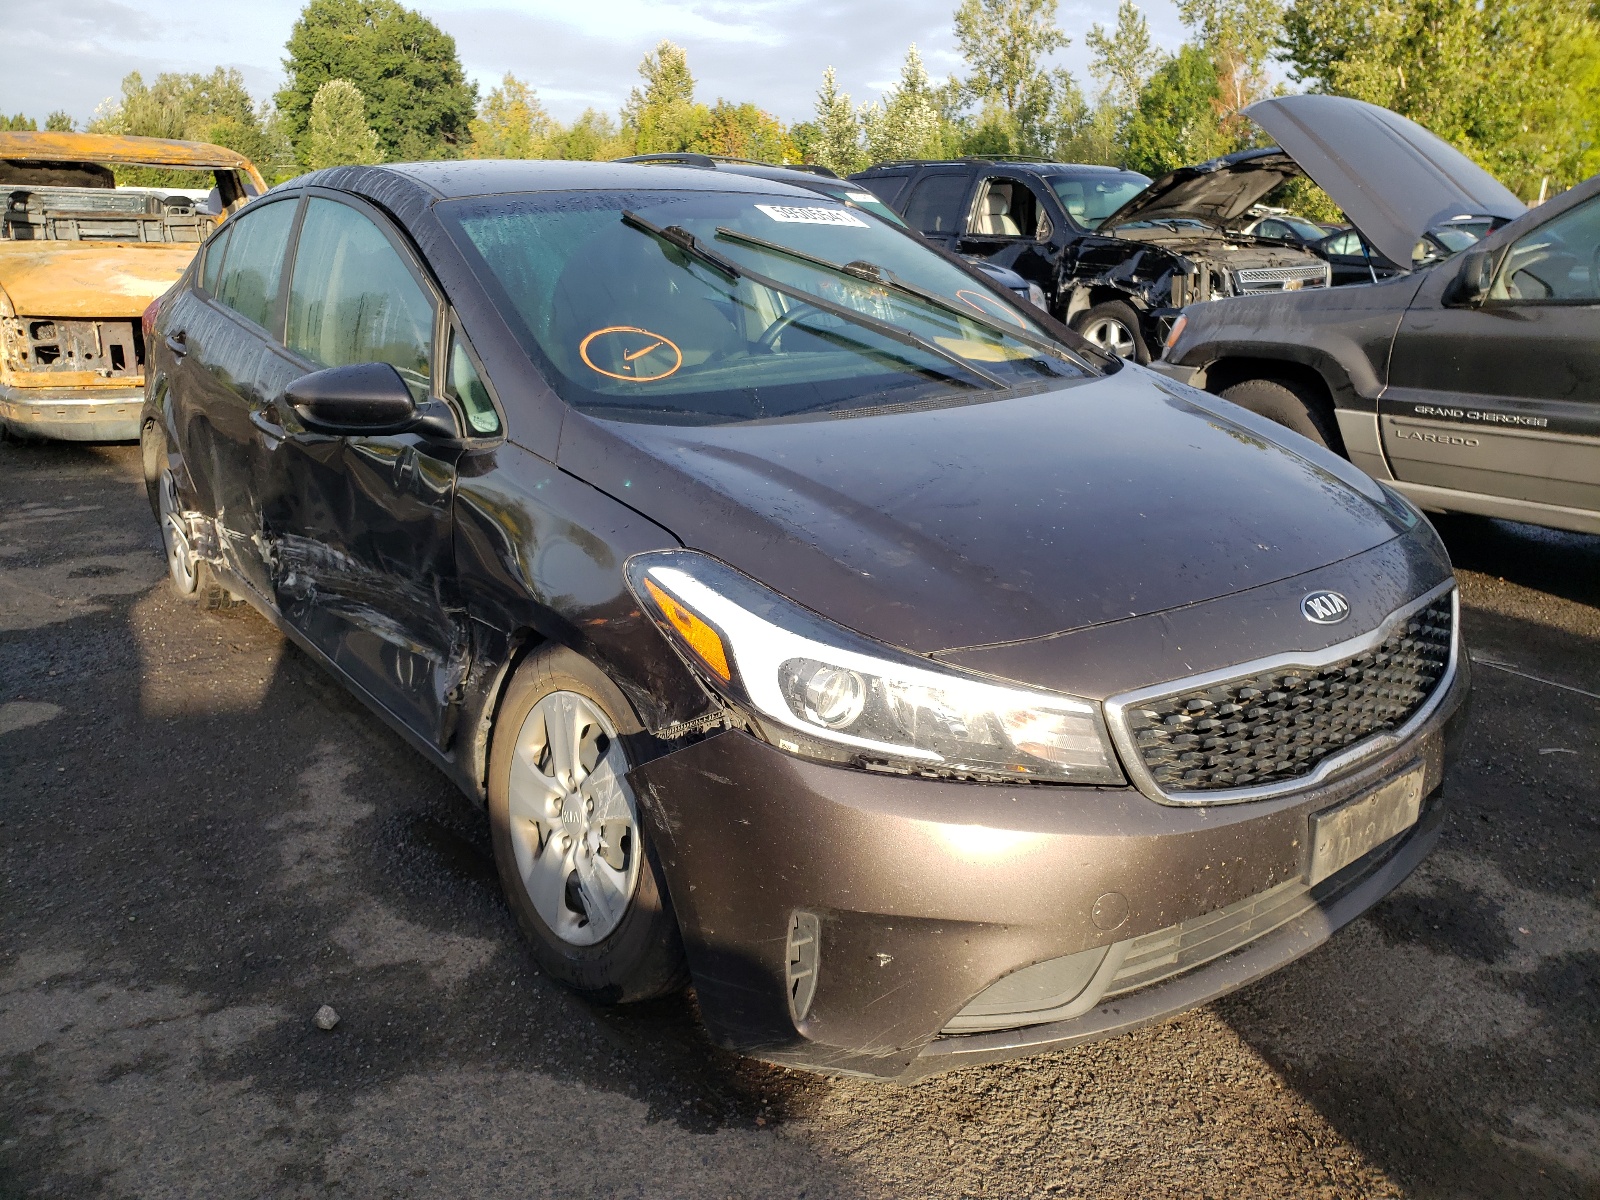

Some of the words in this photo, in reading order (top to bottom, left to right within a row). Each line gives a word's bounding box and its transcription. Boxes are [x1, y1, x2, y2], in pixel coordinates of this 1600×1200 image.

[1414, 405, 1464, 418] GRAND
[1467, 411, 1548, 428] CHEROKEE
[1395, 429, 1480, 447] LAREDO
[1306, 593, 1348, 619] KIA
[563, 810, 580, 824] KIA
